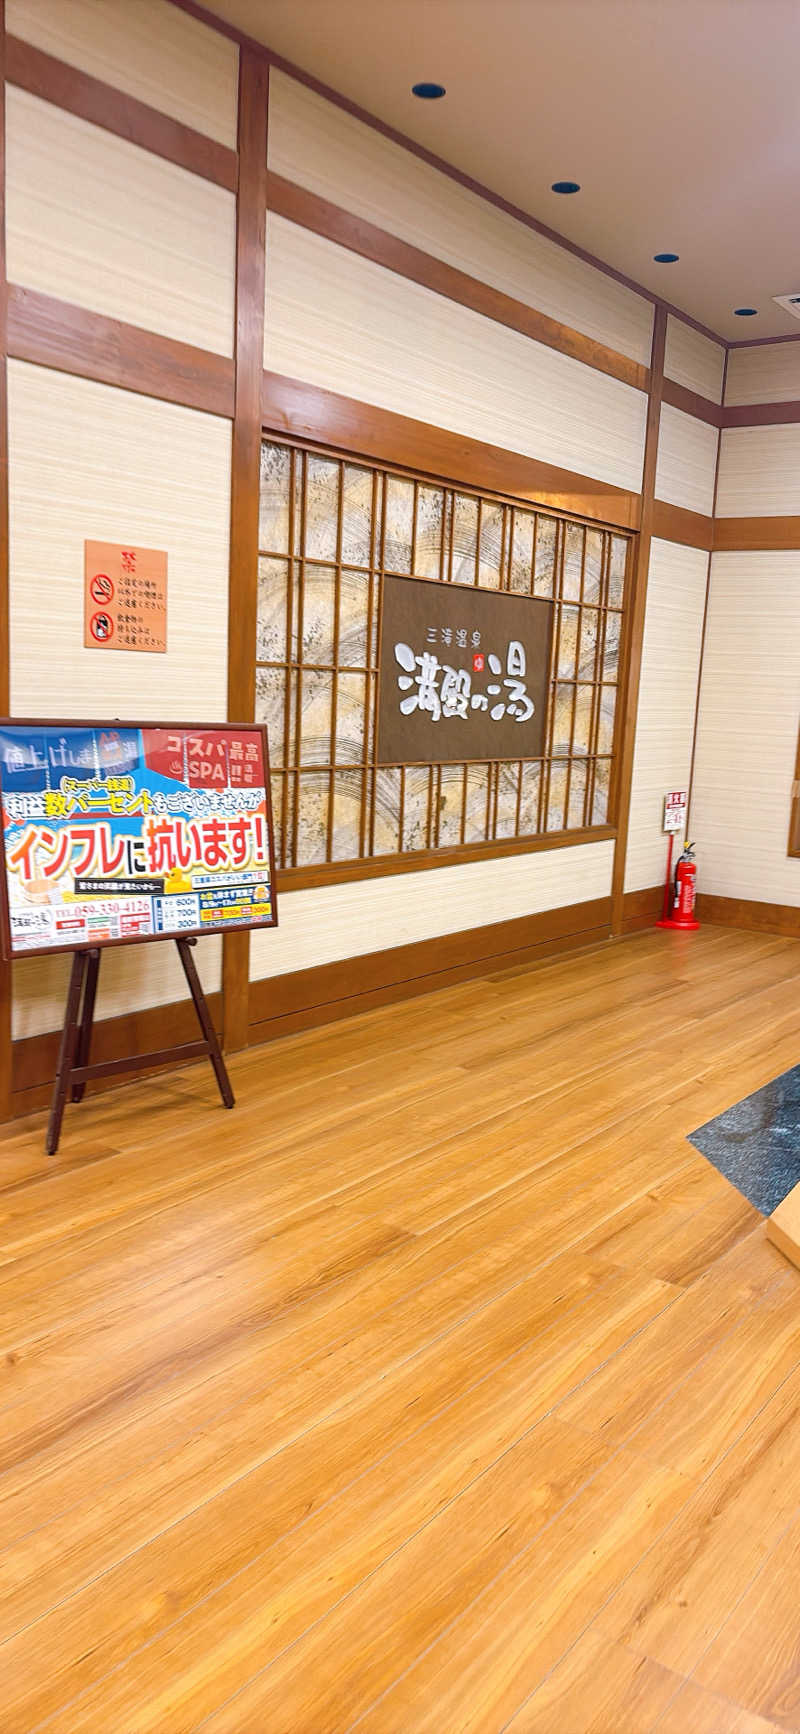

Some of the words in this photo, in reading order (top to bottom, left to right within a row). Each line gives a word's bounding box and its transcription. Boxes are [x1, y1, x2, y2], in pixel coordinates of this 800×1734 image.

[121, 551, 136, 573] 禁
[118, 577, 156, 589] ご指定の場所
[117, 588, 164, 600] 以外での喫煙は
[117, 613, 143, 623] 飲食物の
[117, 624, 150, 636] 持ち込みは
[394, 640, 535, 722] 満殿の湯
[189, 760, 225, 781] SPA
[10, 817, 264, 880] インフレに抗います!
